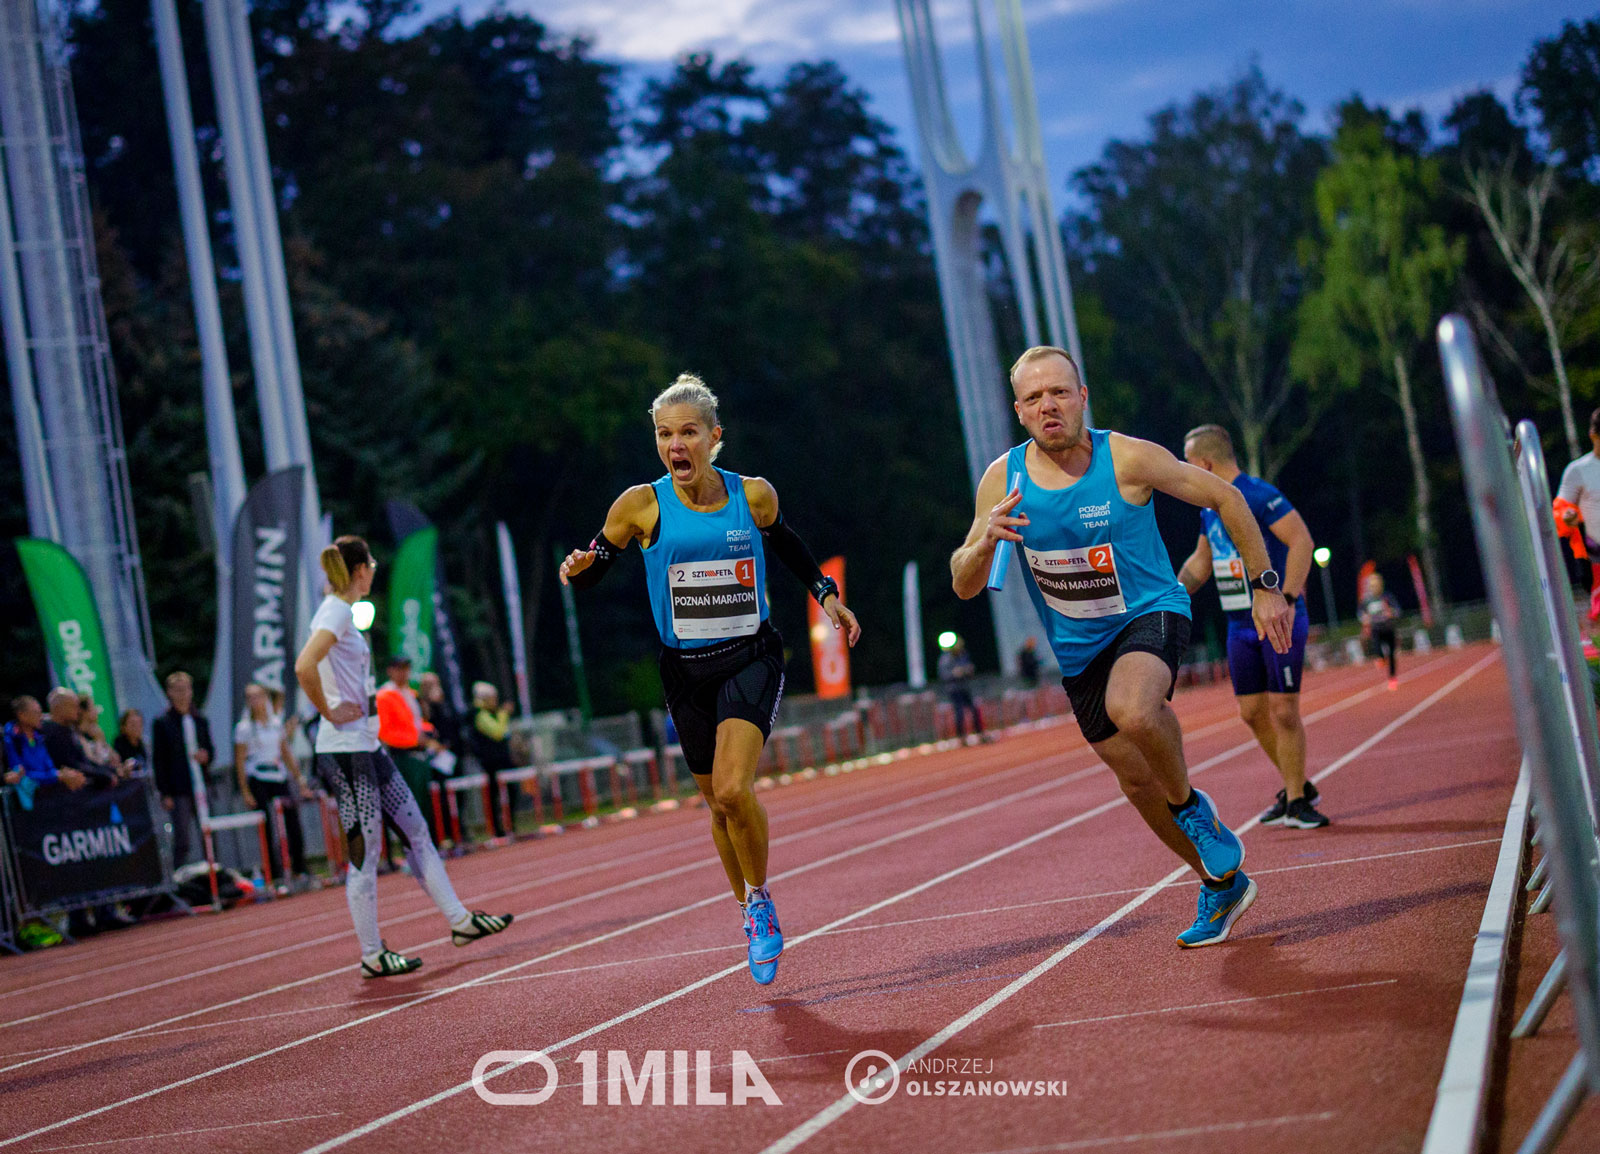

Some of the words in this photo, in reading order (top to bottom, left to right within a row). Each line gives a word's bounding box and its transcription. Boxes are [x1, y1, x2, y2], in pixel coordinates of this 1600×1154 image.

[1080, 510, 1110, 519] maraton
[1084, 520, 1108, 528] TEAM
[728, 544, 751, 552] TEAM
[1031, 555, 1040, 567] 2
[1095, 551, 1108, 567] 2
[676, 570, 686, 582] 2
[741, 563, 751, 580] 1
[1036, 575, 1067, 590] POZNAŃ
[1069, 577, 1115, 590] MARATON
[674, 593, 711, 607] POZNAŃ
[712, 591, 755, 605] MARATON
[253, 528, 287, 690] ARMIN
[42, 824, 132, 866] GARMIN
